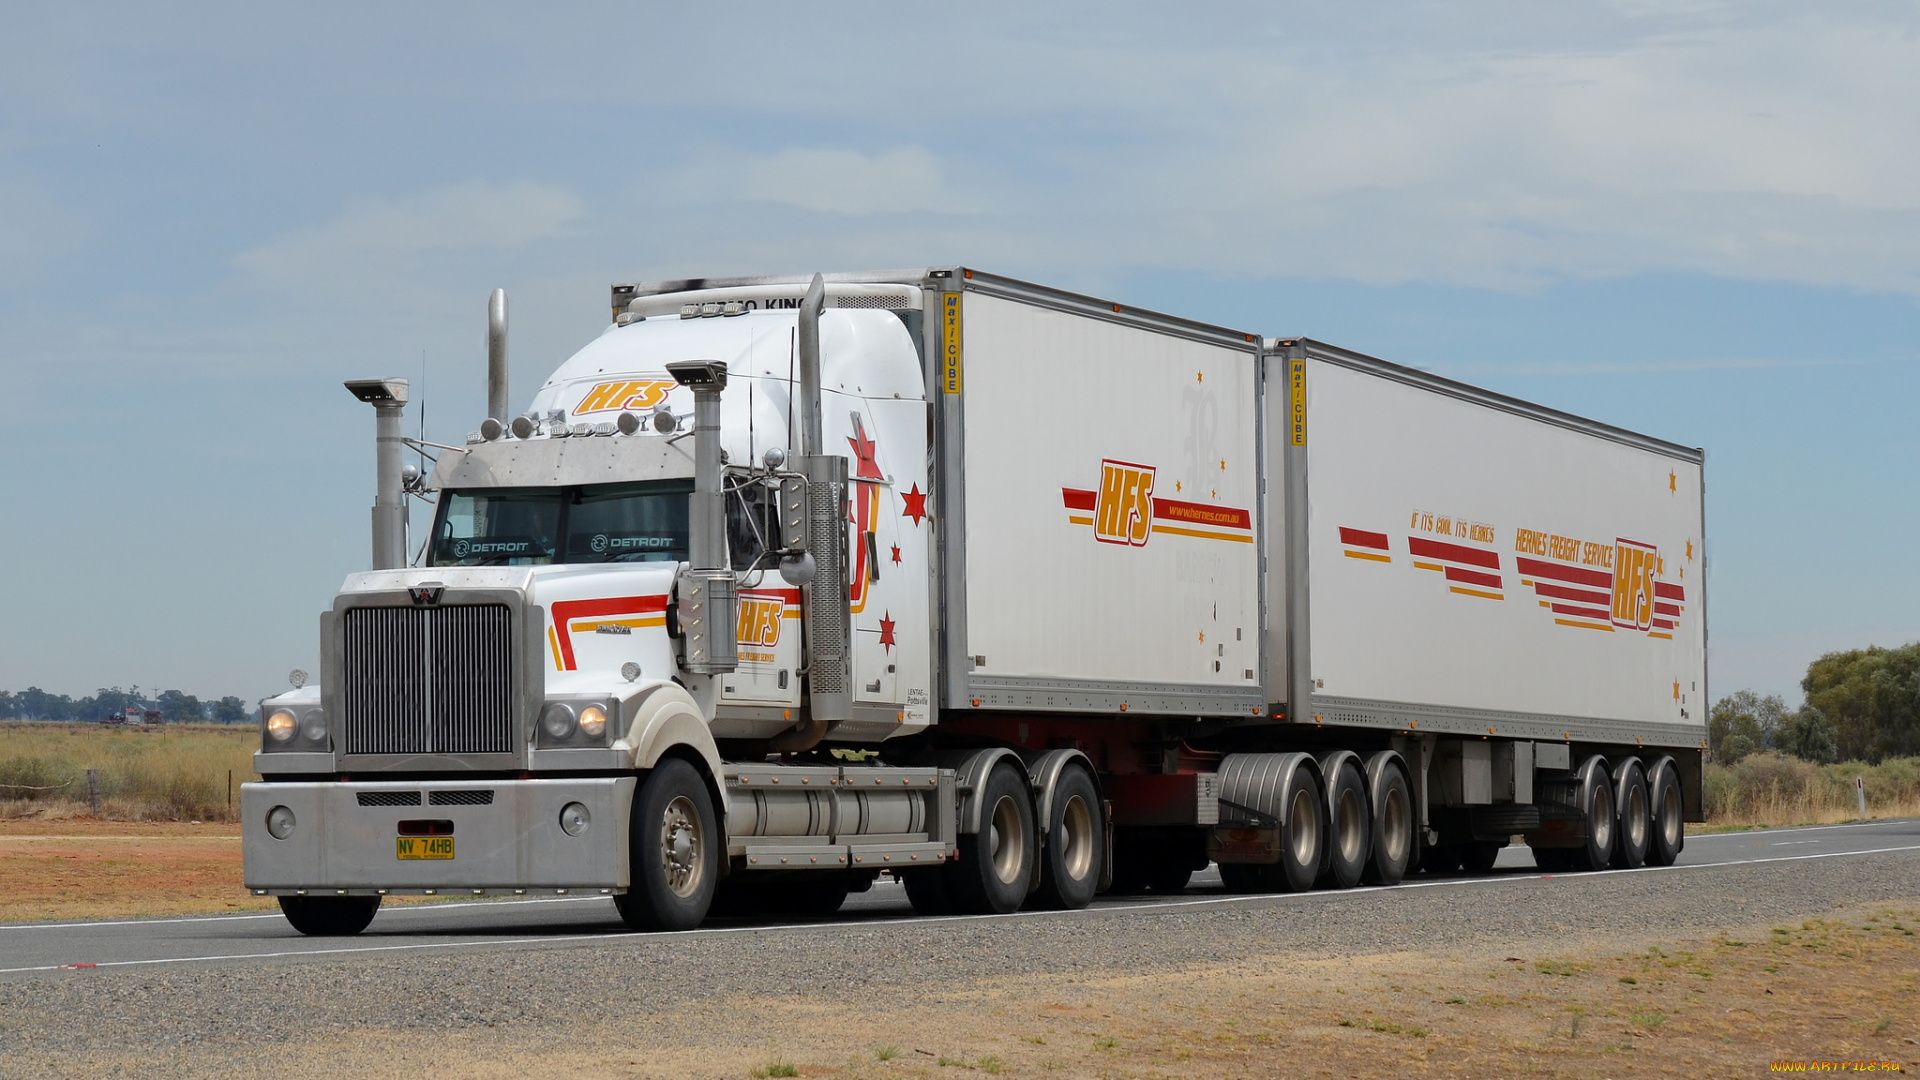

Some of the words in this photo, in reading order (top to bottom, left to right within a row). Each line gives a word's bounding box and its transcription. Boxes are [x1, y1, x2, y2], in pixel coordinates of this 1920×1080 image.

[765, 298, 805, 309] KIN
[572, 379, 680, 416] HFS
[1095, 458, 1156, 547] HFS
[1169, 504, 1240, 524] www.hernes.com.au
[472, 542, 528, 553] DETROIT
[610, 537, 673, 548] DETROIT
[1515, 528, 1547, 557] HERNES
[1549, 534, 1581, 562] FREIGHT
[1583, 541, 1614, 569] SERVICE
[1611, 537, 1657, 631] HFS
[737, 596, 783, 647] HFS
[421, 839, 452, 854] 74HB
